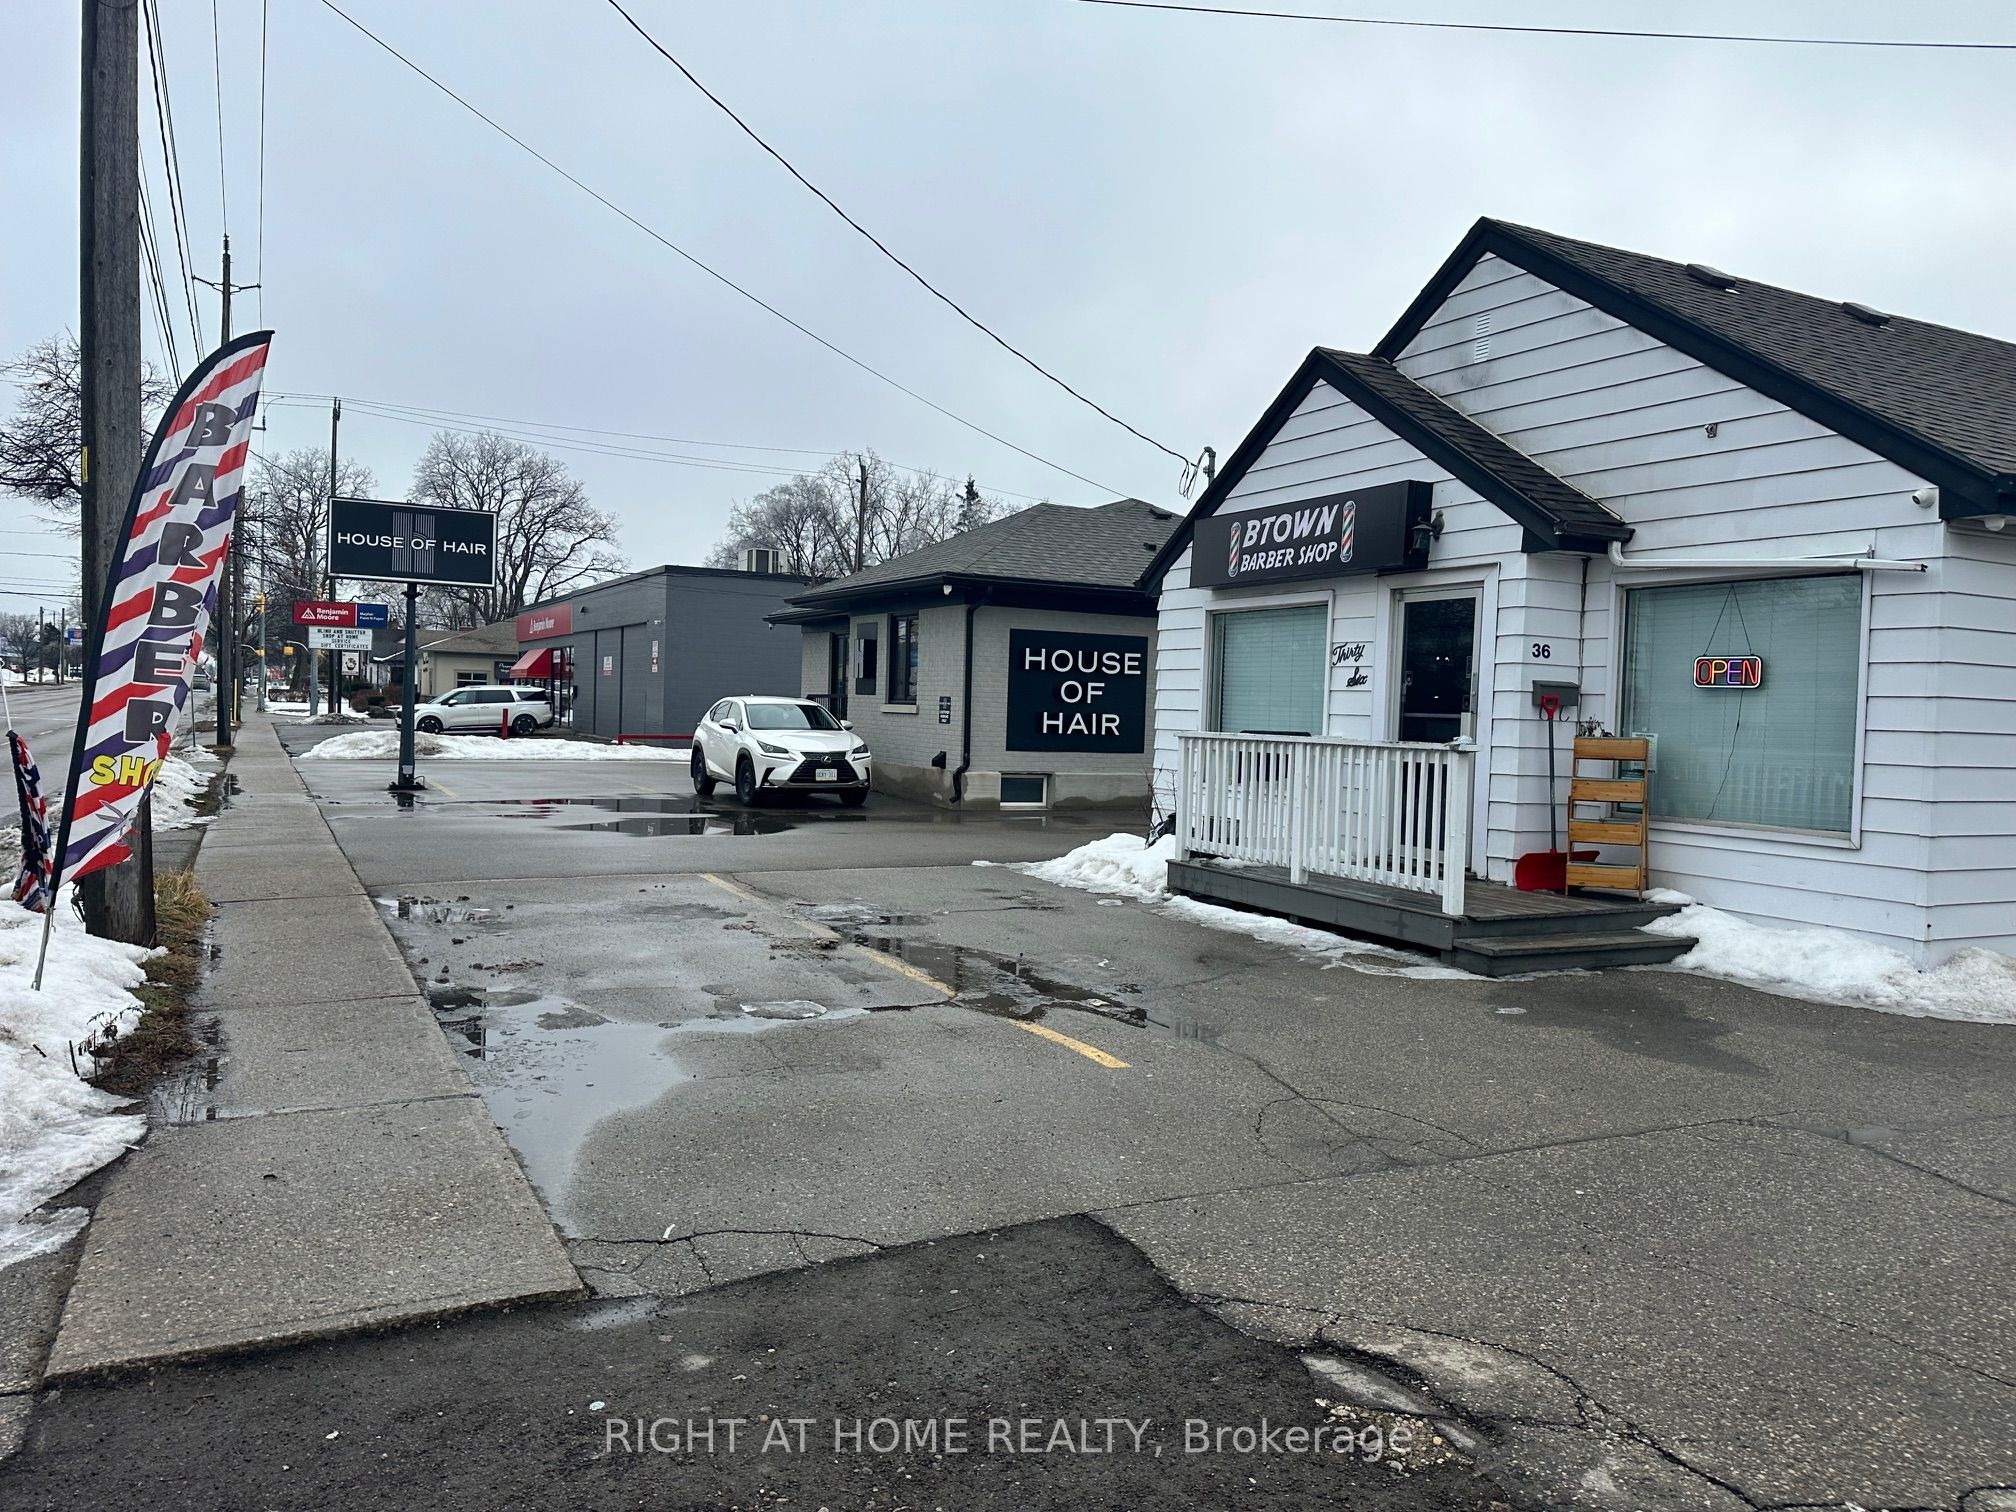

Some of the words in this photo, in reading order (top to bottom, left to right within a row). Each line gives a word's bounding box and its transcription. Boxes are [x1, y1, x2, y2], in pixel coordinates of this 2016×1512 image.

[1242, 503, 1340, 548] BTOWN
[337, 531, 404, 548] HOUSE
[411, 539, 436, 550] OF
[443, 541, 487, 555] HAIR
[1240, 547, 1294, 572] BARBER
[1297, 541, 1338, 565] SHOP
[124, 401, 237, 743] BARBER
[316, 607, 349, 616] Benjamin
[316, 613, 340, 621] Moore
[1025, 647, 1142, 675] HOUSE
[1332, 643, 1365, 665] Thirty
[1531, 643, 1551, 659] 36
[1346, 666, 1369, 687] Six
[1696, 659, 1760, 685] OPEN
[1060, 680, 1105, 704] OF
[1042, 711, 1120, 736] HAIR
